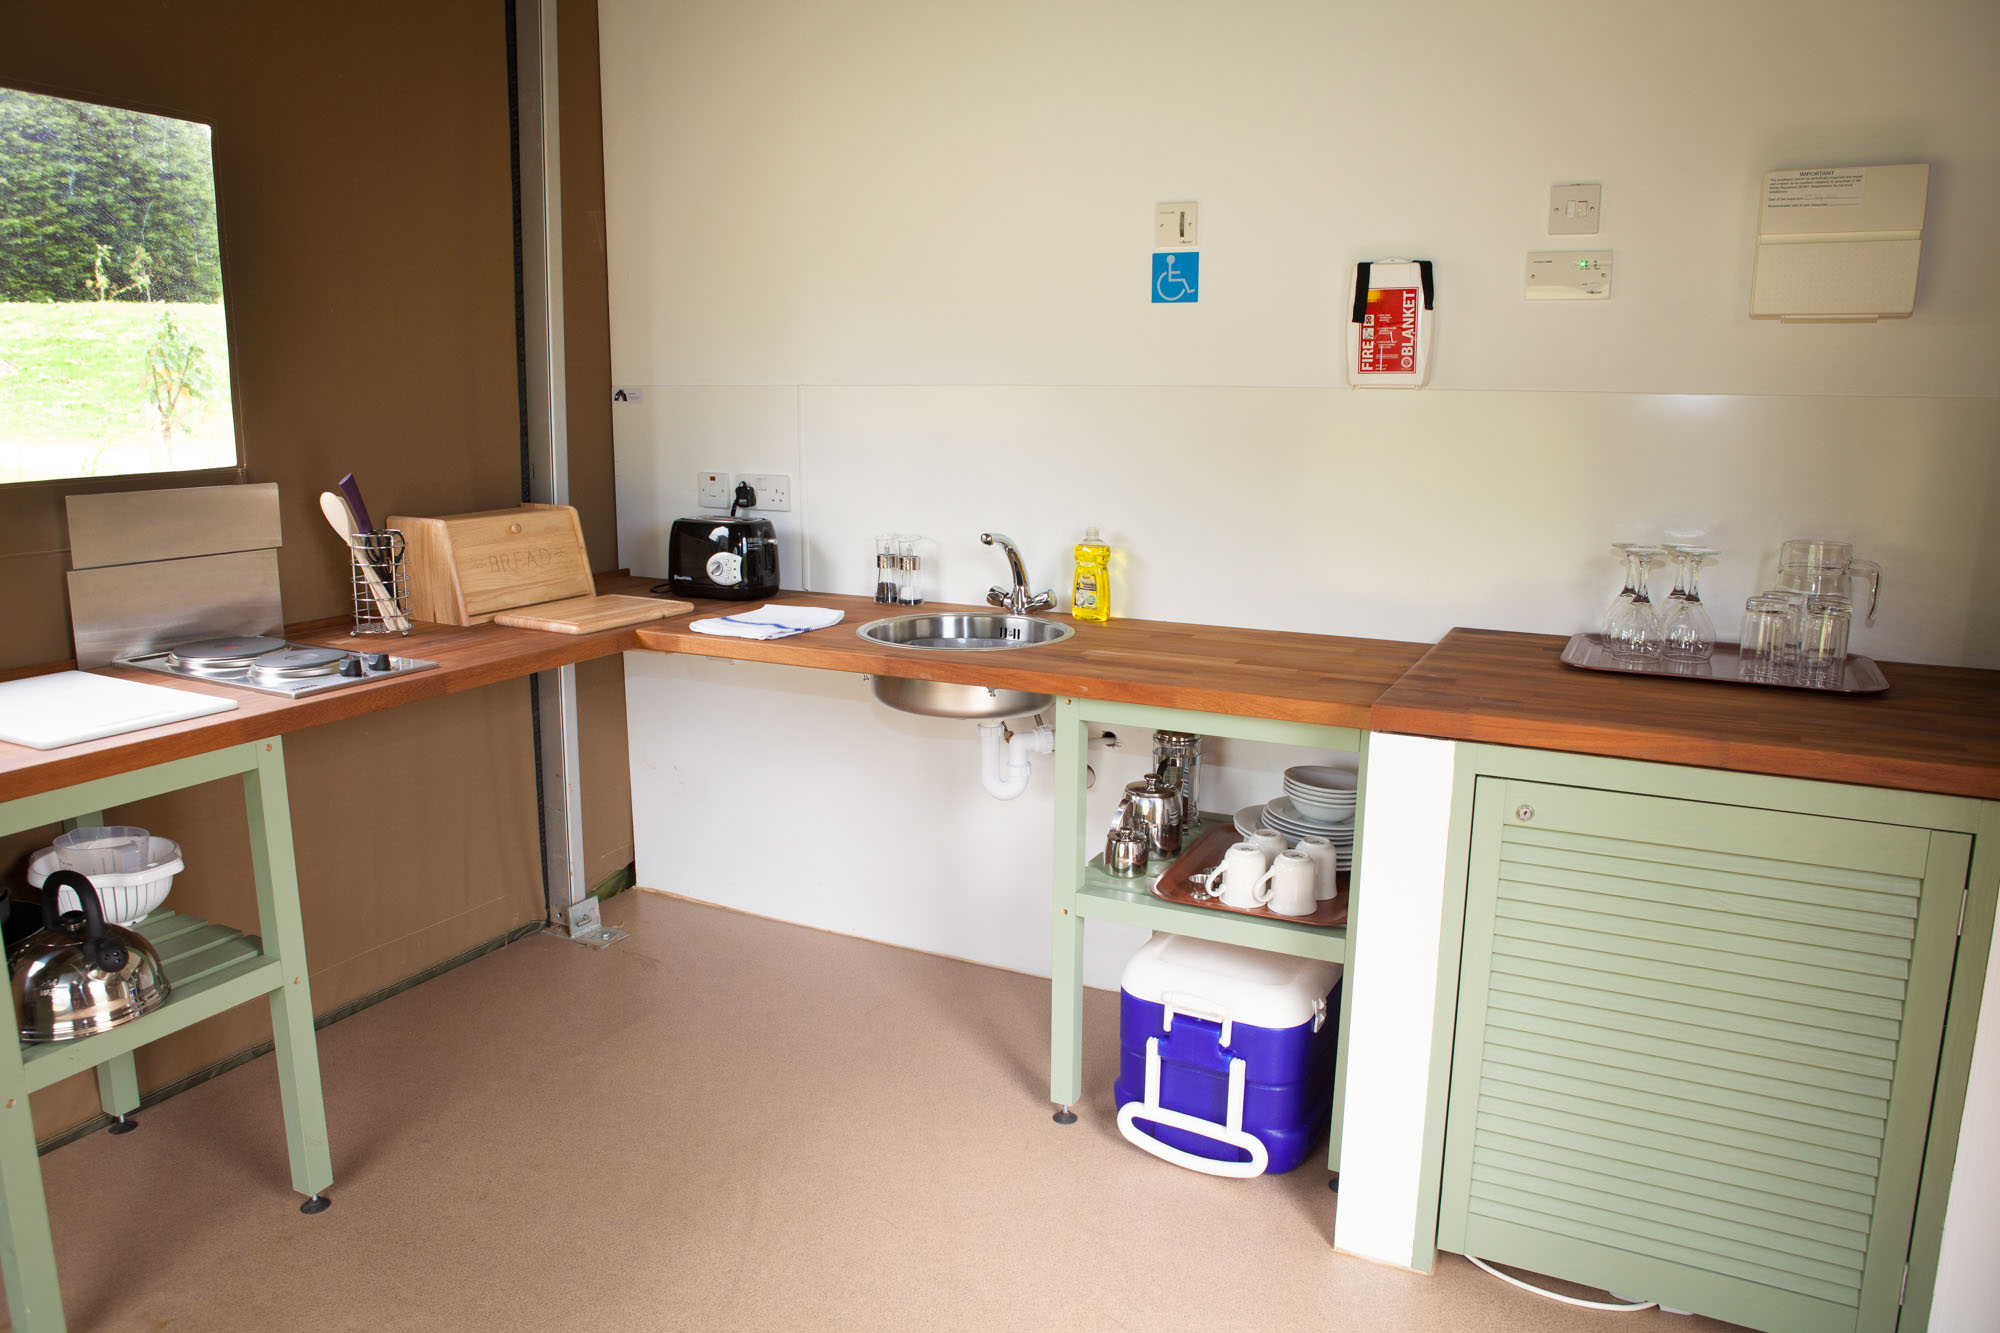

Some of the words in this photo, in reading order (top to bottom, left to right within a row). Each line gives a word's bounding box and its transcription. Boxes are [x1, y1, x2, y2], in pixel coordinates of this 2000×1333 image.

[1400, 290, 1416, 356] BLANKET
[1361, 341, 1375, 371] FIRE
[488, 547, 552, 574] BREAD
